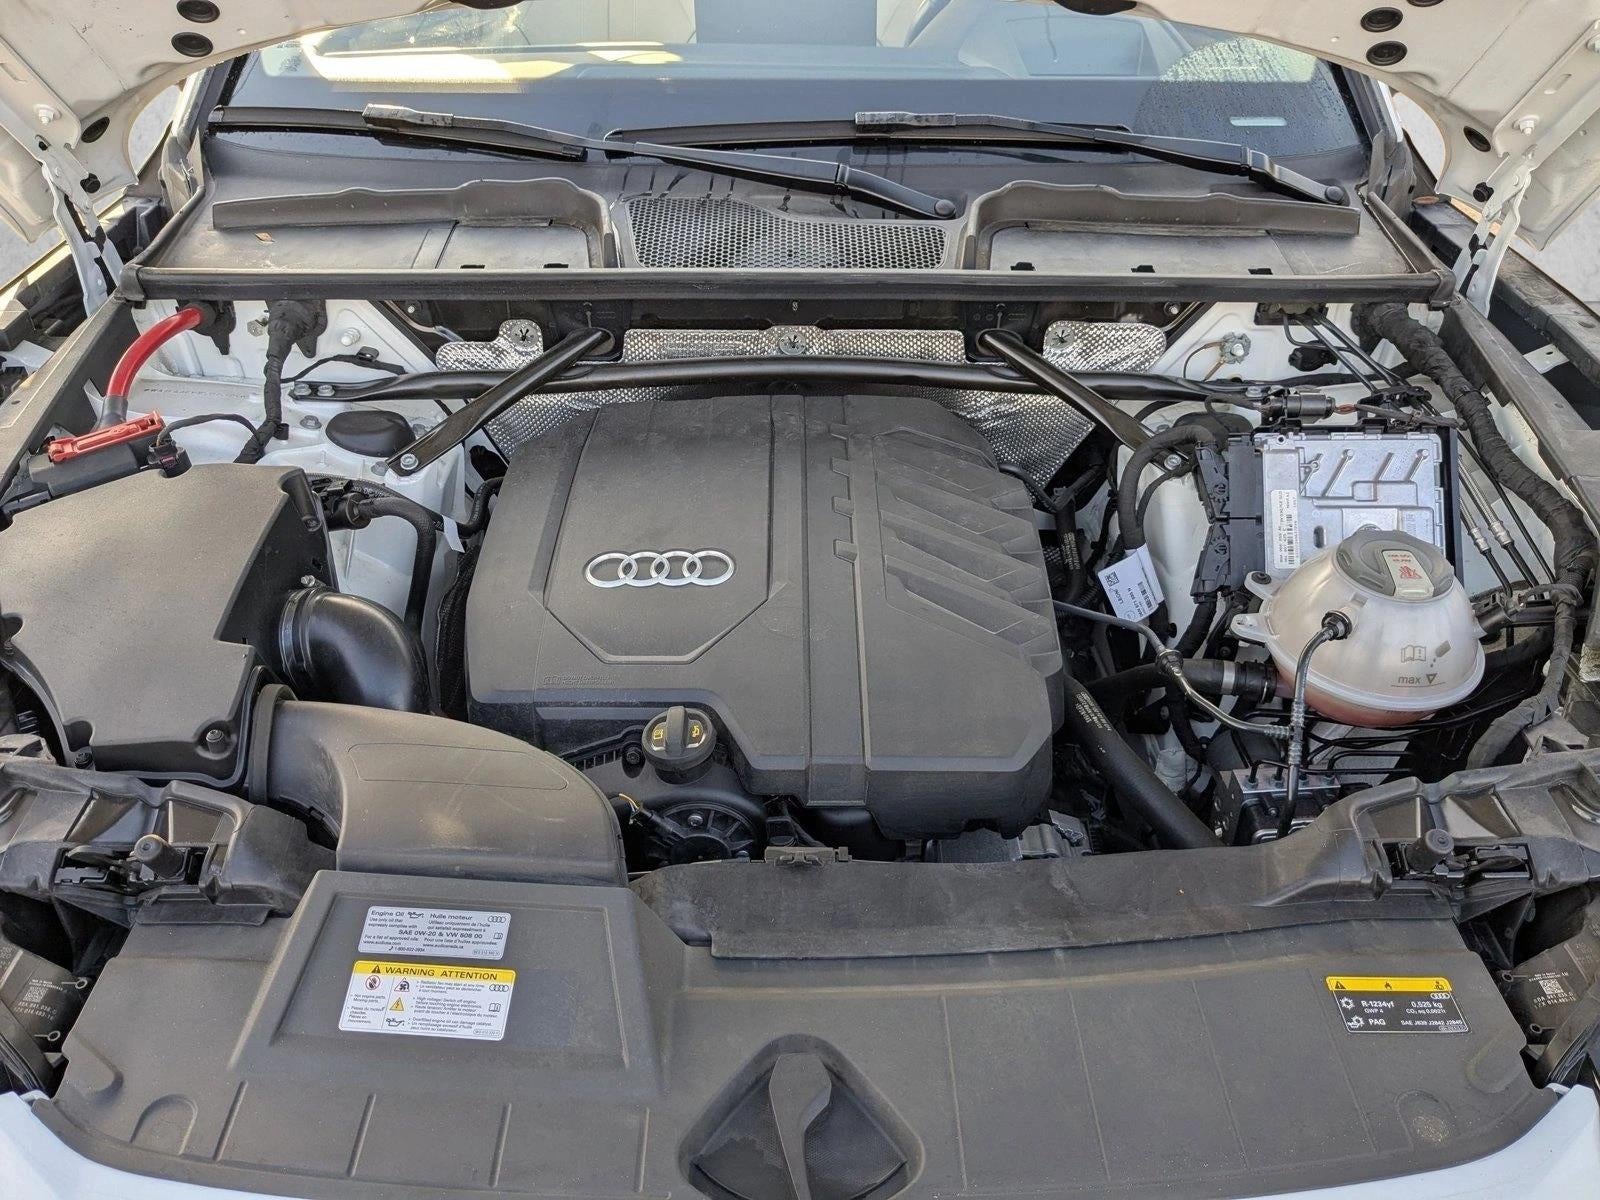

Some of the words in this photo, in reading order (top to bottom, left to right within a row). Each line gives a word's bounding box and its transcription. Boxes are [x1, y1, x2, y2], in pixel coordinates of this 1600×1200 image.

[1398, 676, 1421, 684] max
[385, 966, 435, 976] WARNING
[440, 970, 497, 980] ATTENTION
[1361, 1000, 1394, 1009] R-1234yf
